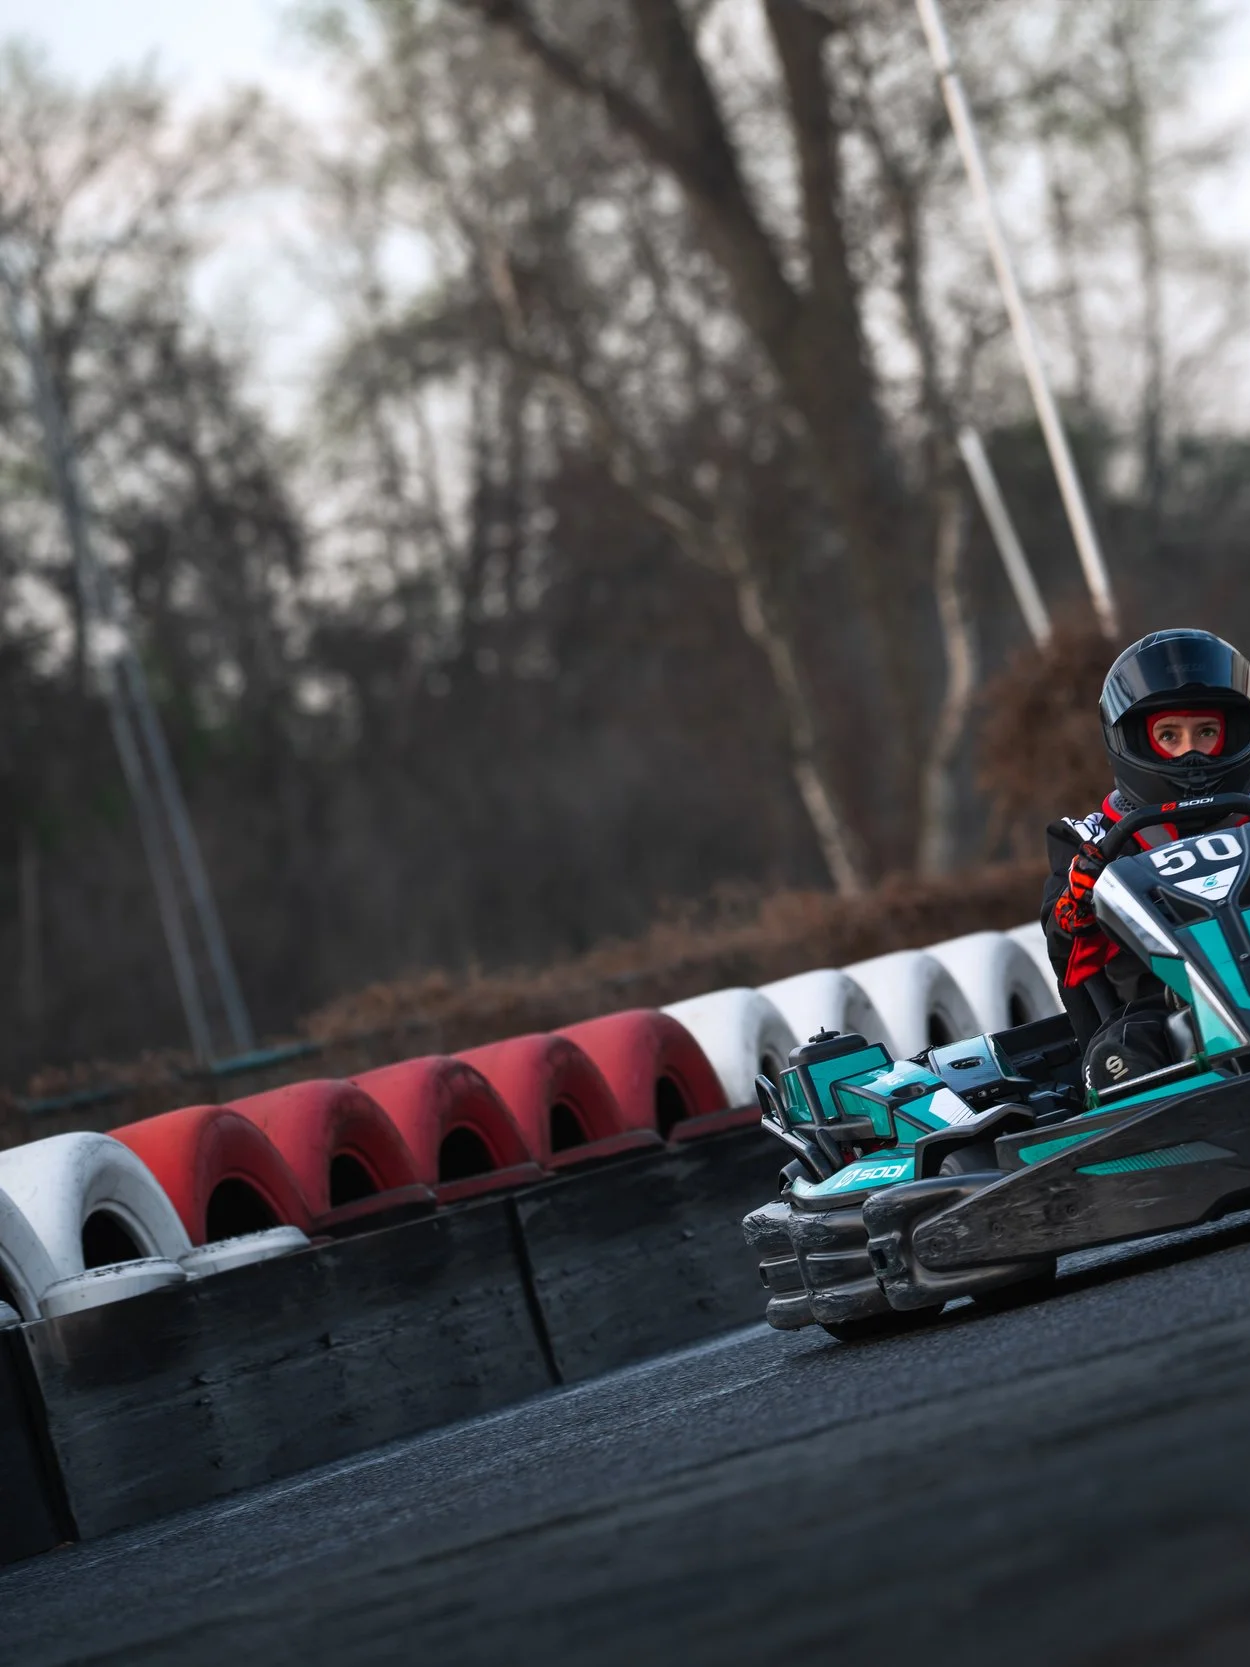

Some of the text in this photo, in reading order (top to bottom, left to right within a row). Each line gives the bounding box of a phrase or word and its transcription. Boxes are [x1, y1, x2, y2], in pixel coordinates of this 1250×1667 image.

[1178, 796, 1214, 809] SODI
[1149, 833, 1243, 876] 50
[855, 1164, 908, 1182] SODI
